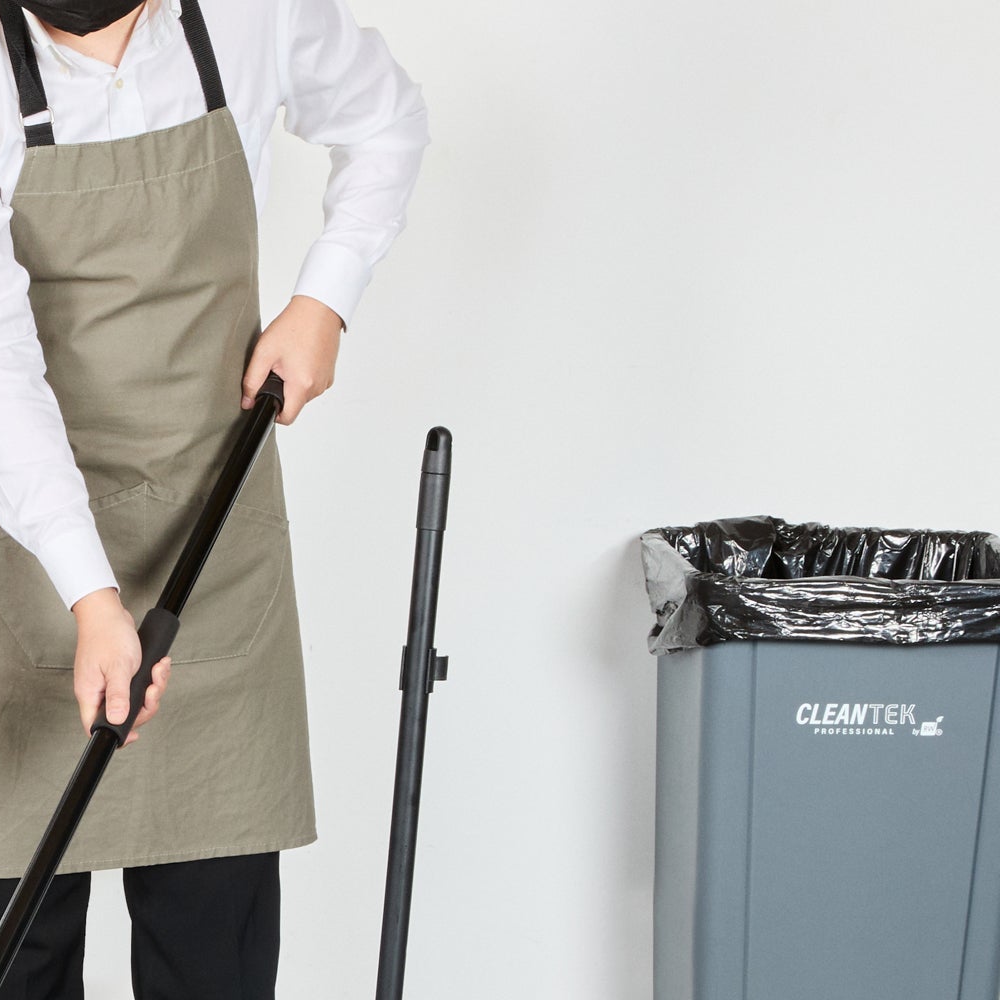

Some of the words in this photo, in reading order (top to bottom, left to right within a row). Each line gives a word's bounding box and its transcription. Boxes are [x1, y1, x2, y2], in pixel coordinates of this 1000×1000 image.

[795, 702, 916, 725] CLEANTEK
[814, 727, 895, 736] PROFESSIONAL
[912, 728, 920, 736] by
